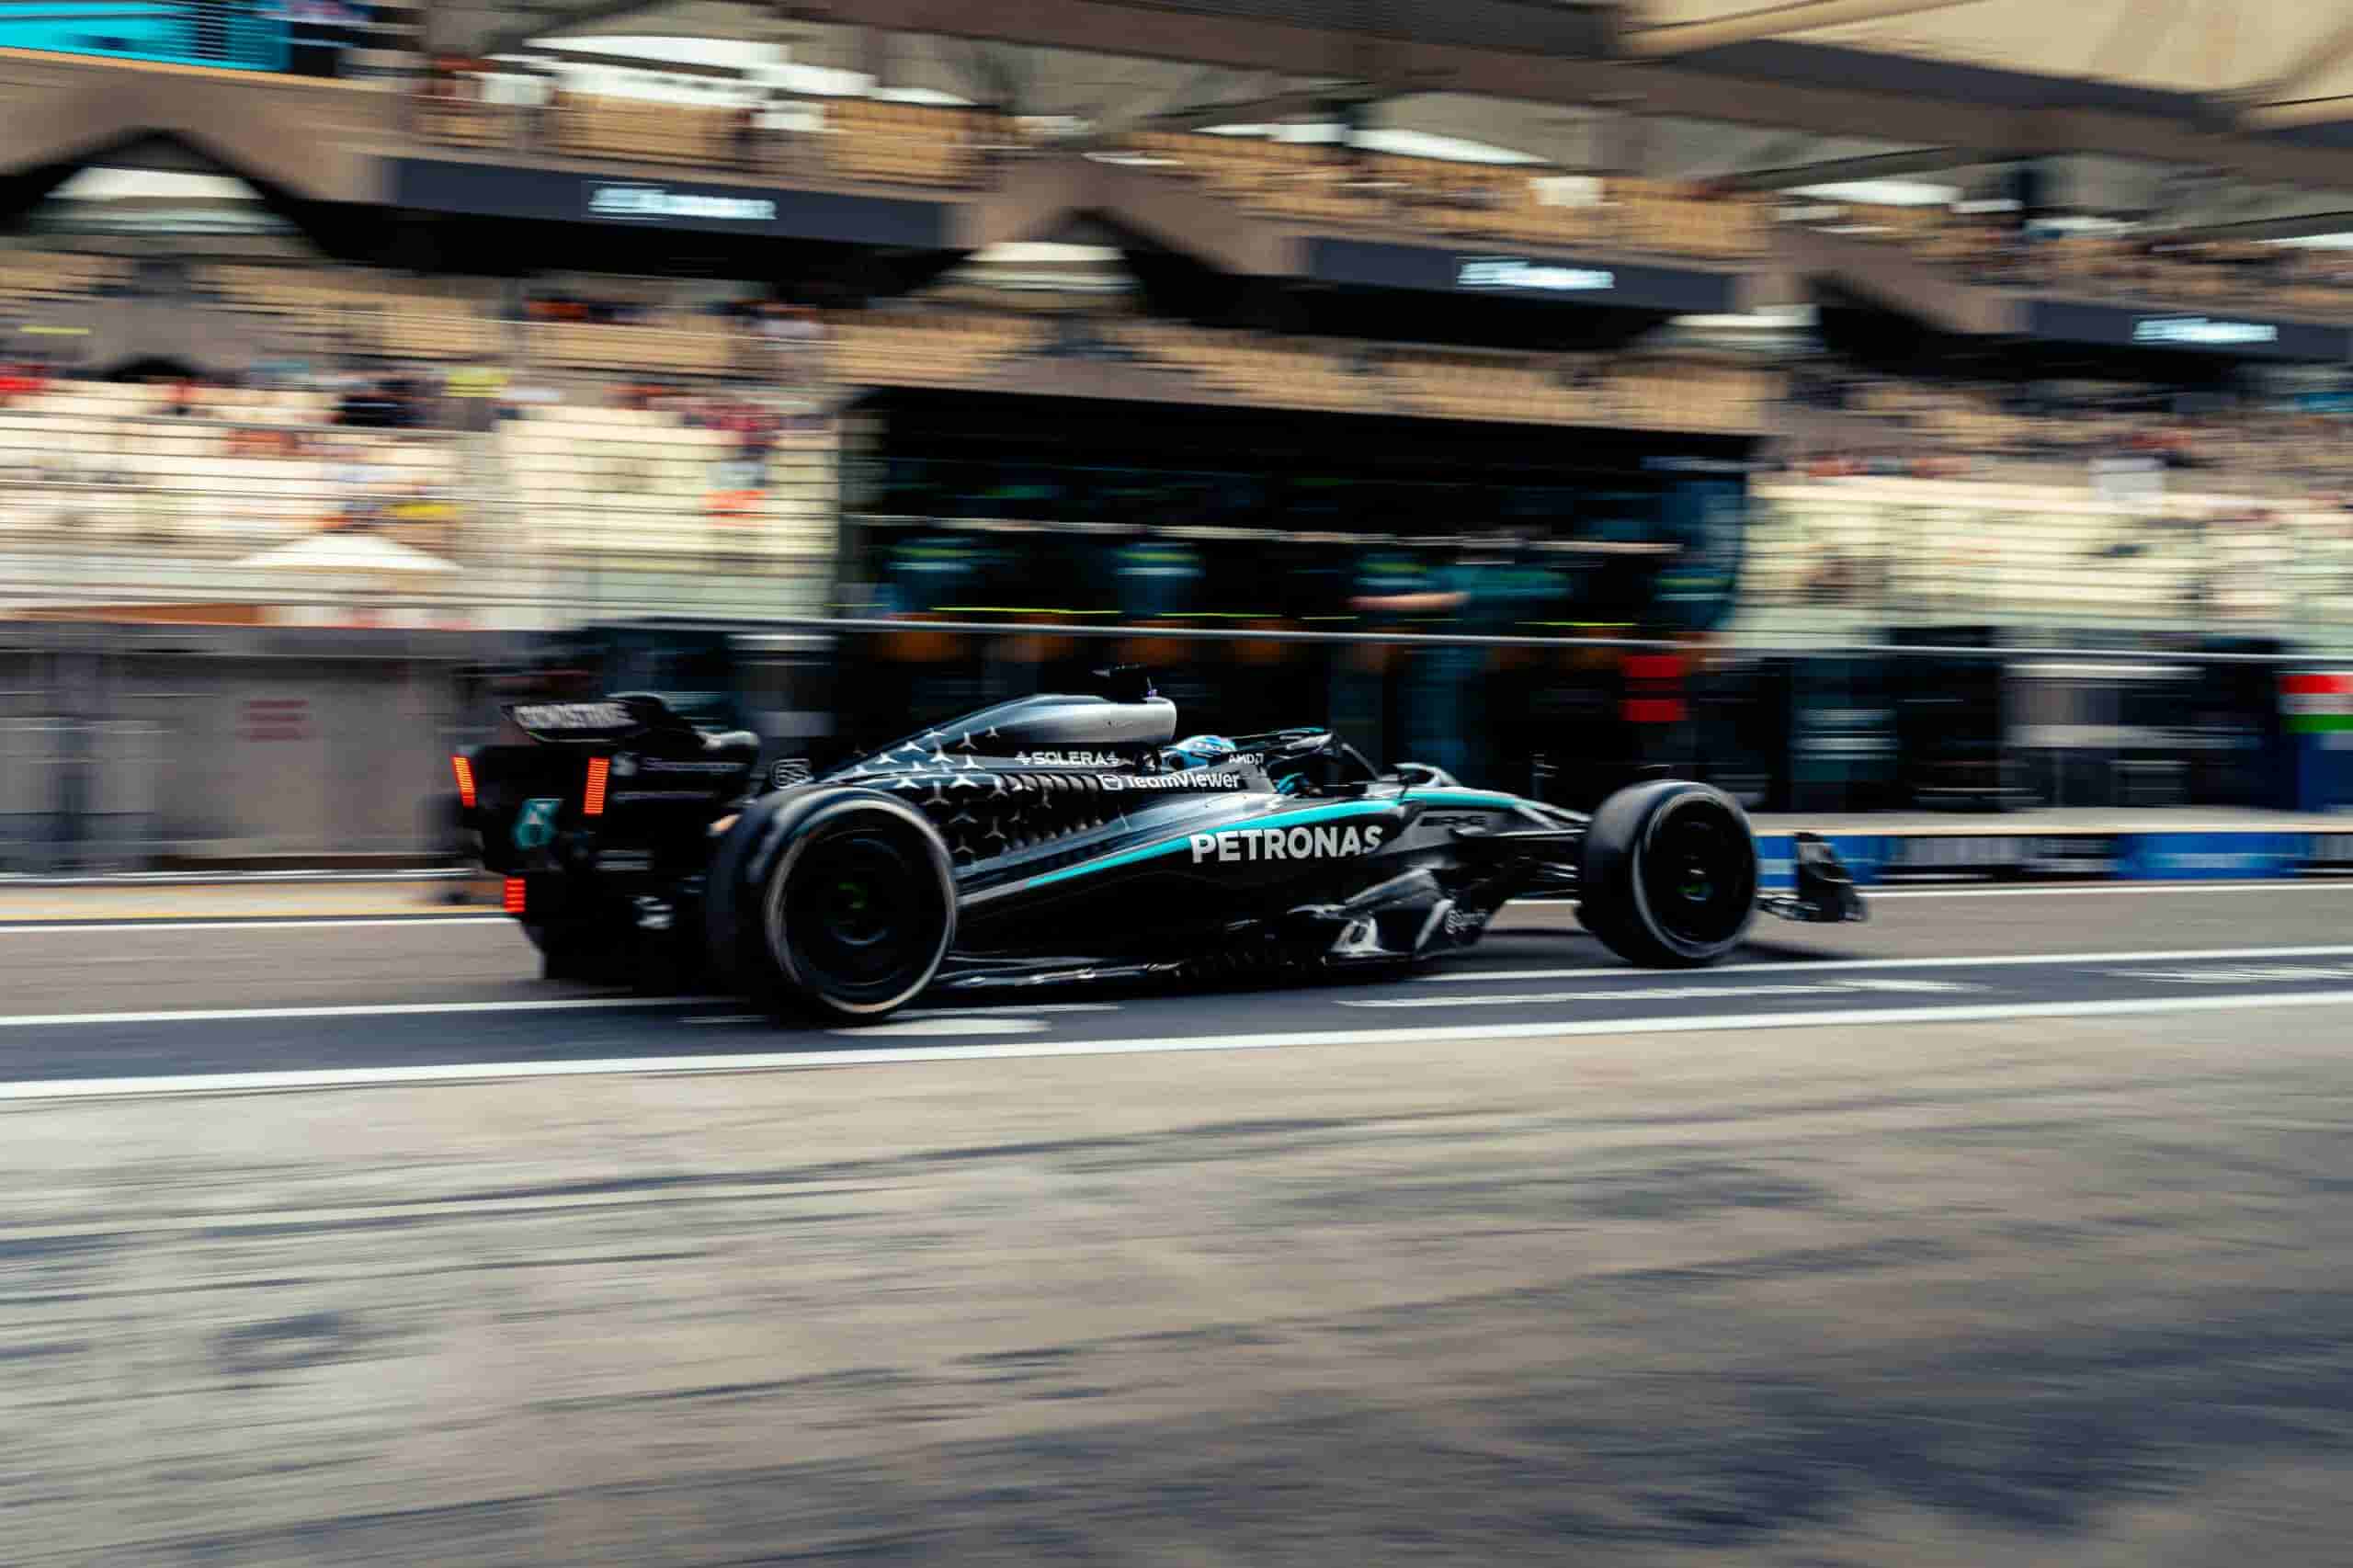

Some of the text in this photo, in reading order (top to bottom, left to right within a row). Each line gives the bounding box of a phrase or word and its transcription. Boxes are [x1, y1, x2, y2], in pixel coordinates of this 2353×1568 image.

[1030, 752, 1104, 766] SOLERA
[1228, 754, 1255, 765] AMD
[1128, 770, 1240, 789] TeamViewer
[1190, 825, 1382, 864] PETRONAS
